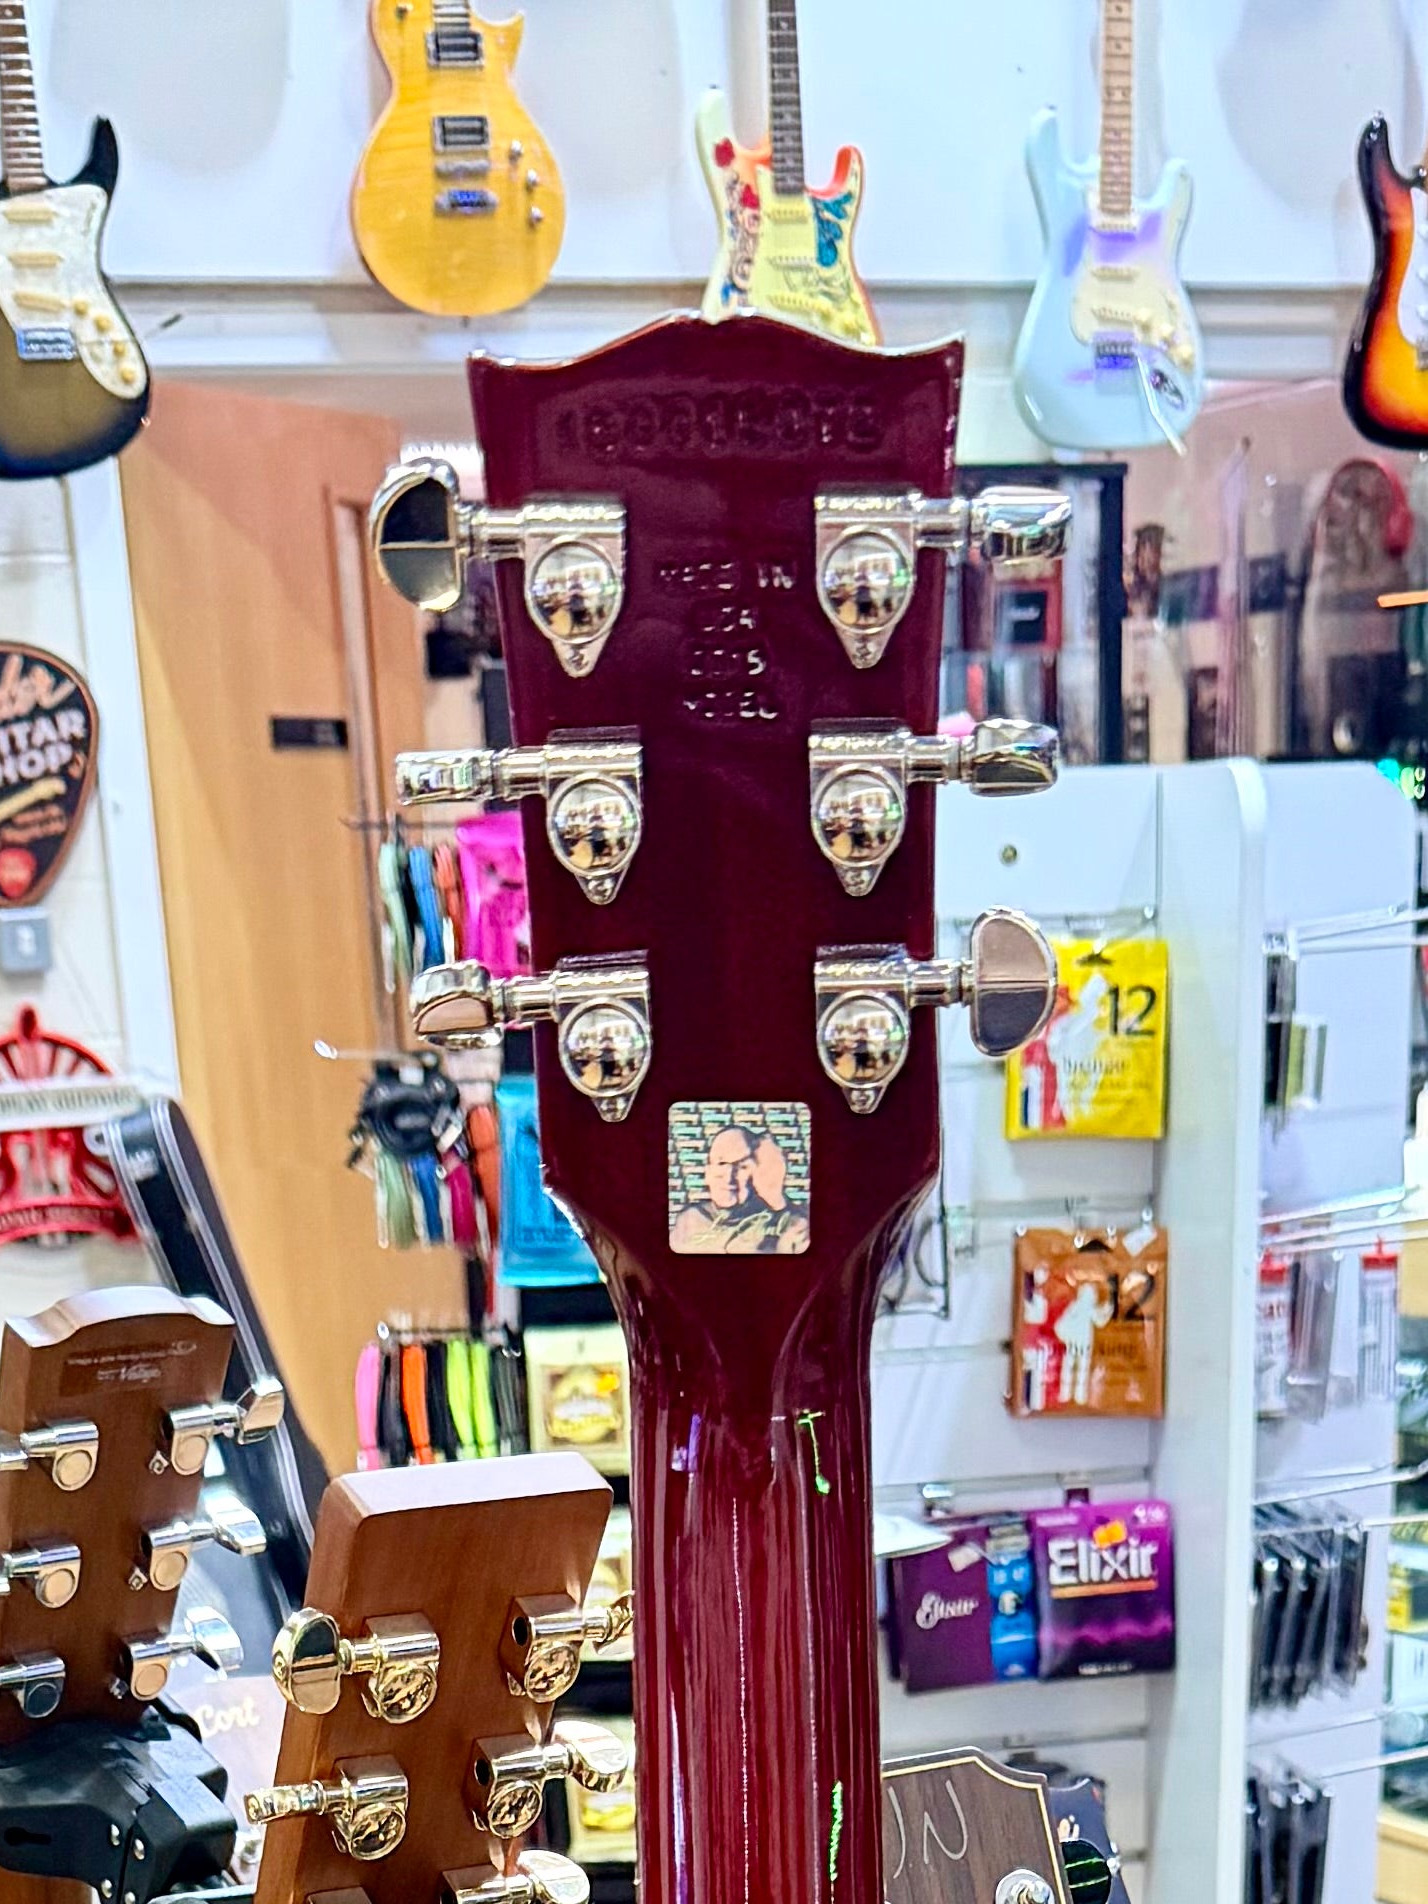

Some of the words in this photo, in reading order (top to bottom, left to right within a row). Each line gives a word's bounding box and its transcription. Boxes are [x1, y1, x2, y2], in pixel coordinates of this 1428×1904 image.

[1107, 985, 1156, 1037] 12
[1109, 1272, 1156, 1322] 12
[1048, 1536, 1159, 1586] Elixir
[193, 1697, 261, 1738] Cort
